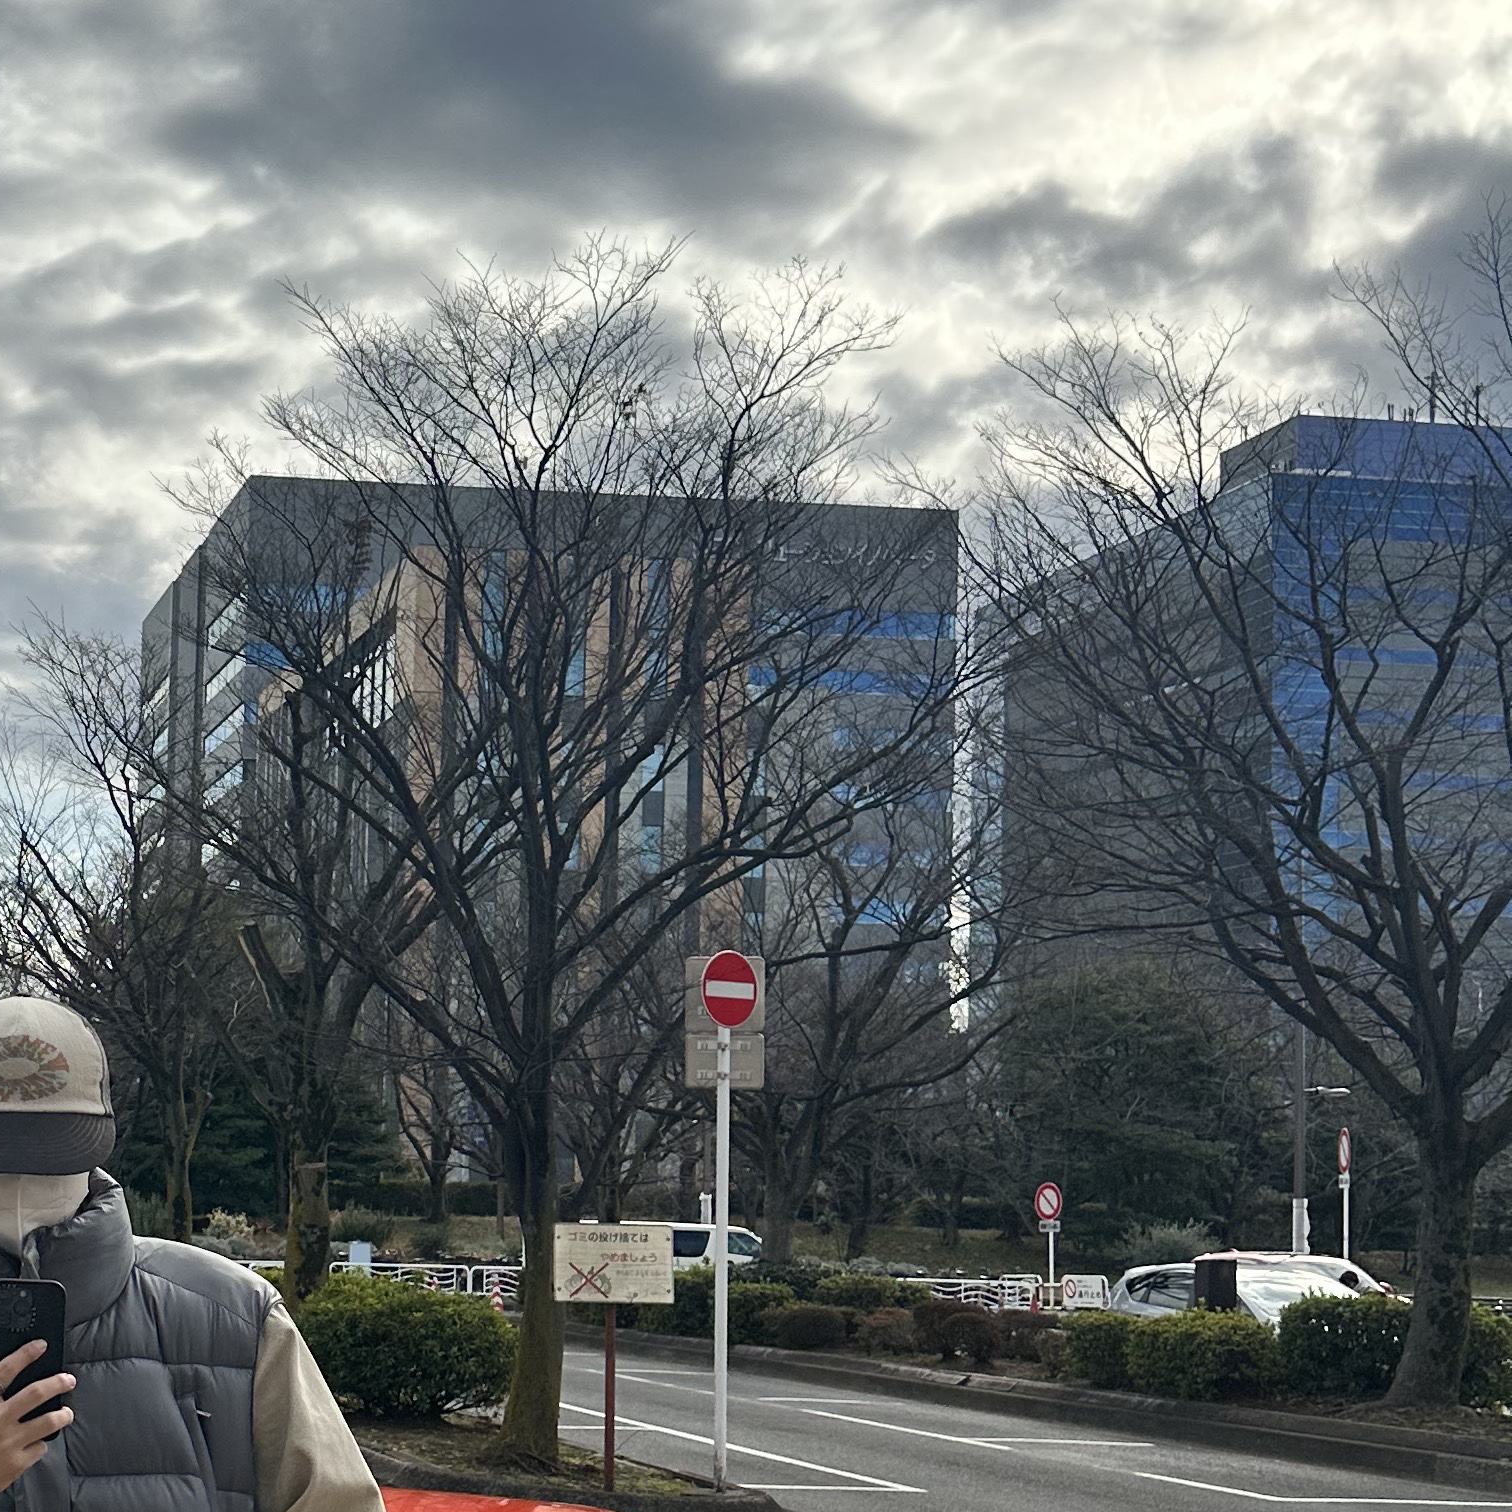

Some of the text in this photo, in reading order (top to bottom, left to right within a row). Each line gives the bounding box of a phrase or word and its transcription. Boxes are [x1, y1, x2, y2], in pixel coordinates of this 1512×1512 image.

[567, 1231, 649, 1243] ゴミの投げ捨ては
[600, 1252, 658, 1263] やめましょう
